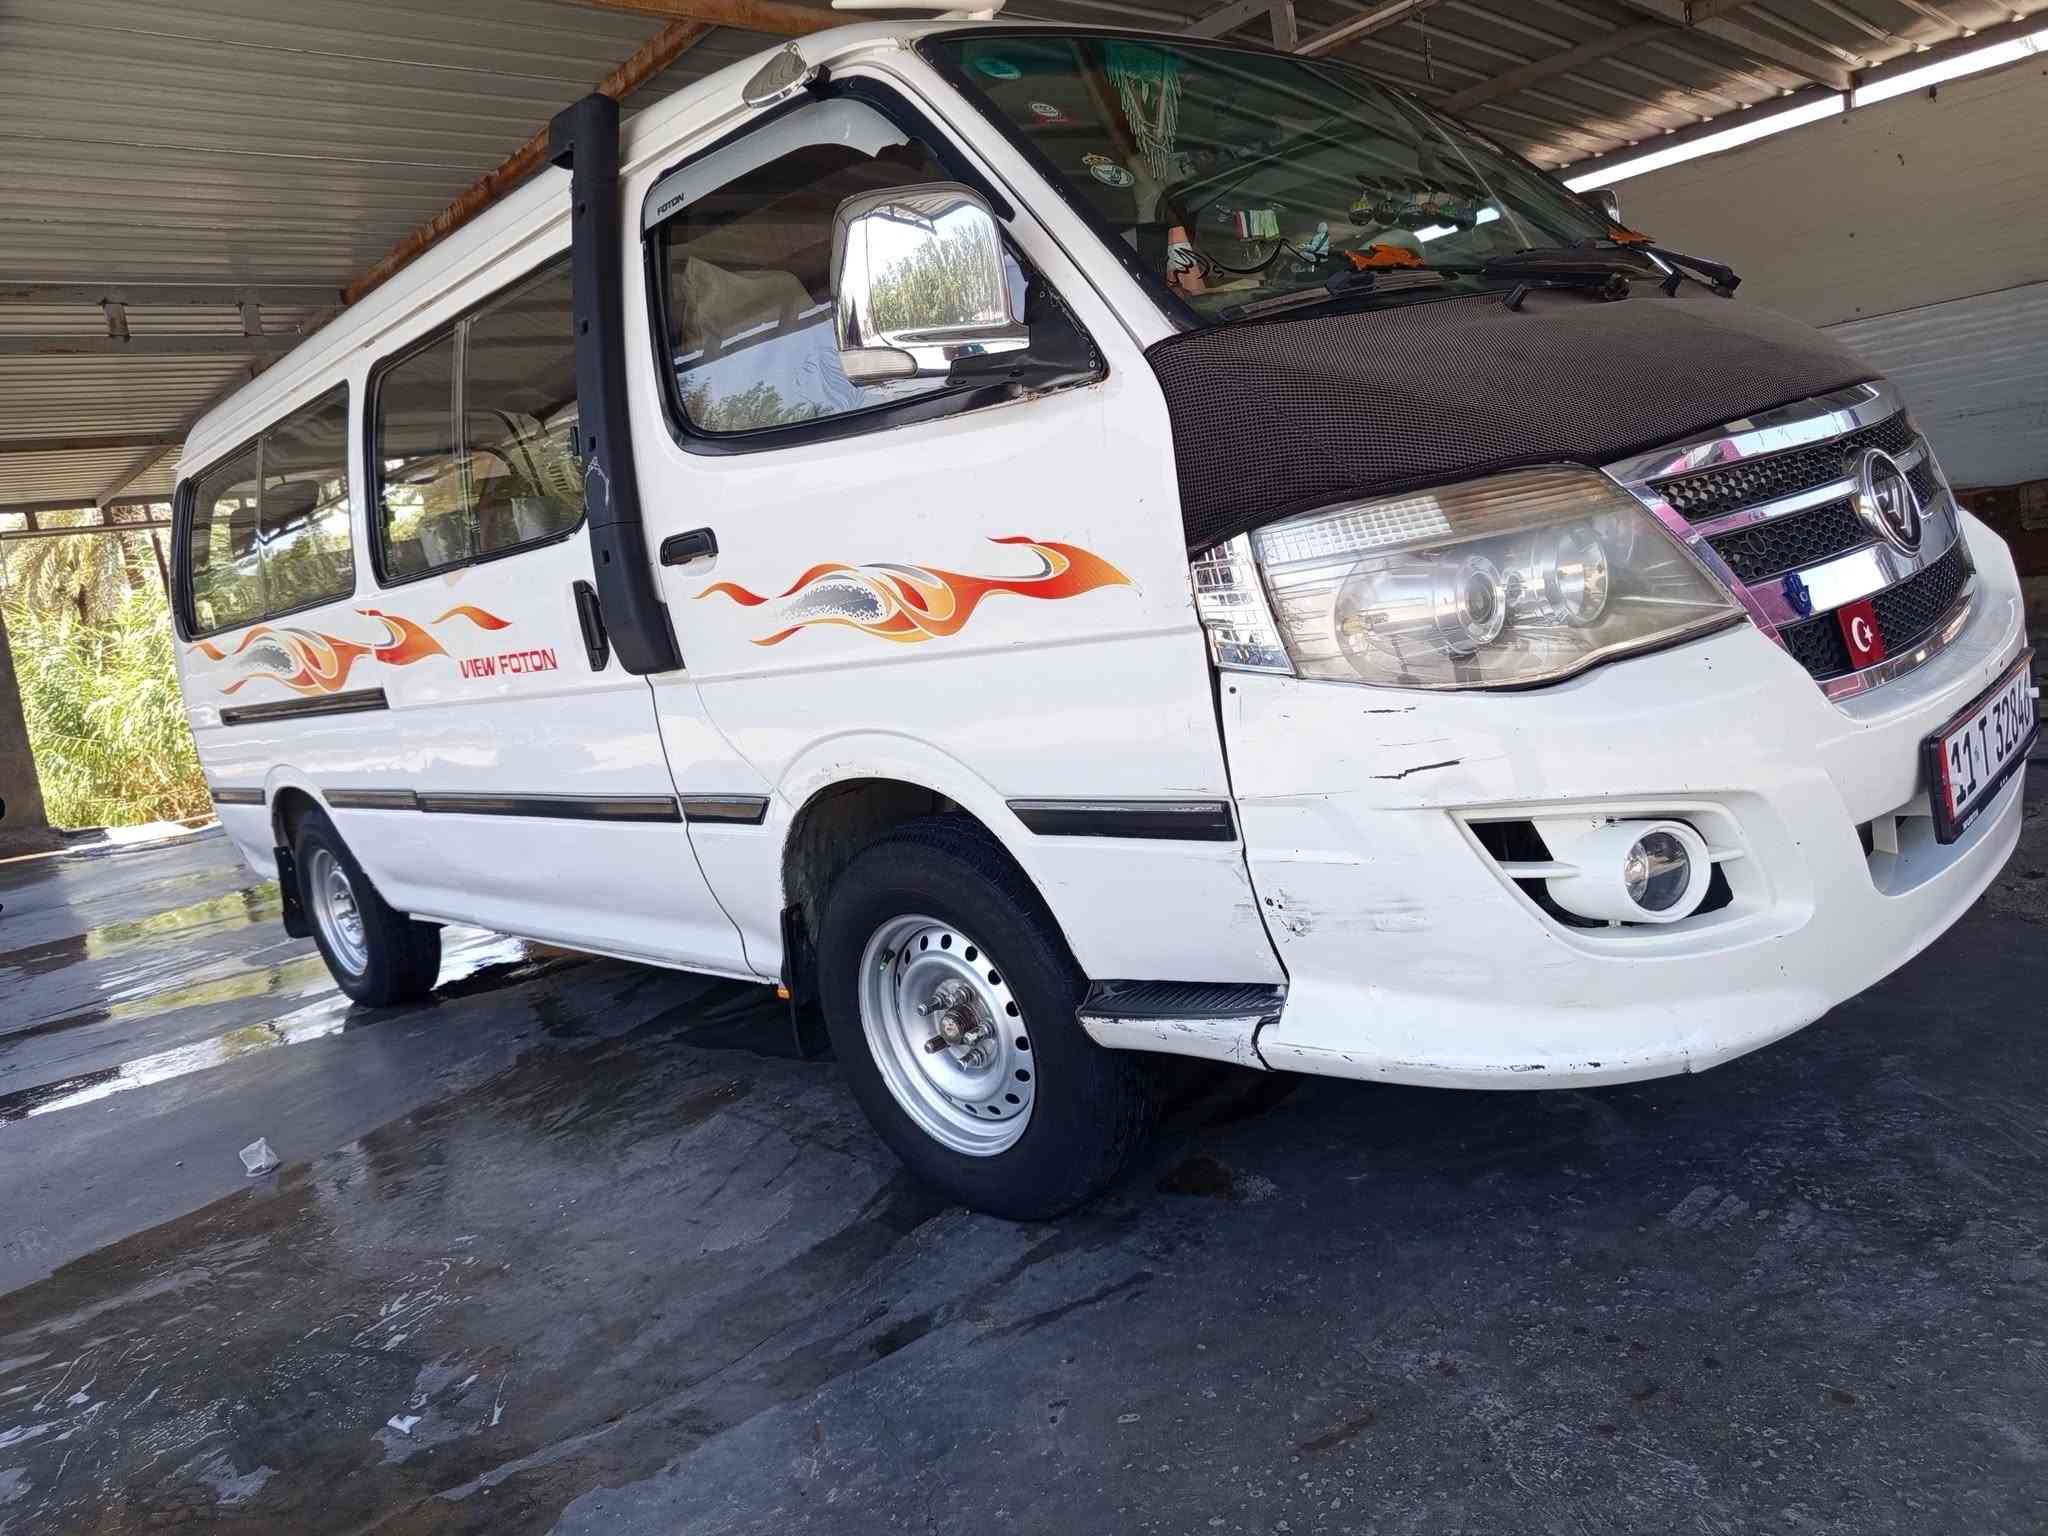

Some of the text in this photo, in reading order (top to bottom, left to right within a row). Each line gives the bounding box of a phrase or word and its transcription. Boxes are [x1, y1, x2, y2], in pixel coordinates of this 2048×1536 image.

[657, 192, 685, 217] FOTON
[460, 648, 559, 679] VIEW FOTON
[1951, 731, 1977, 806] 11
[1979, 716, 1991, 777] T
